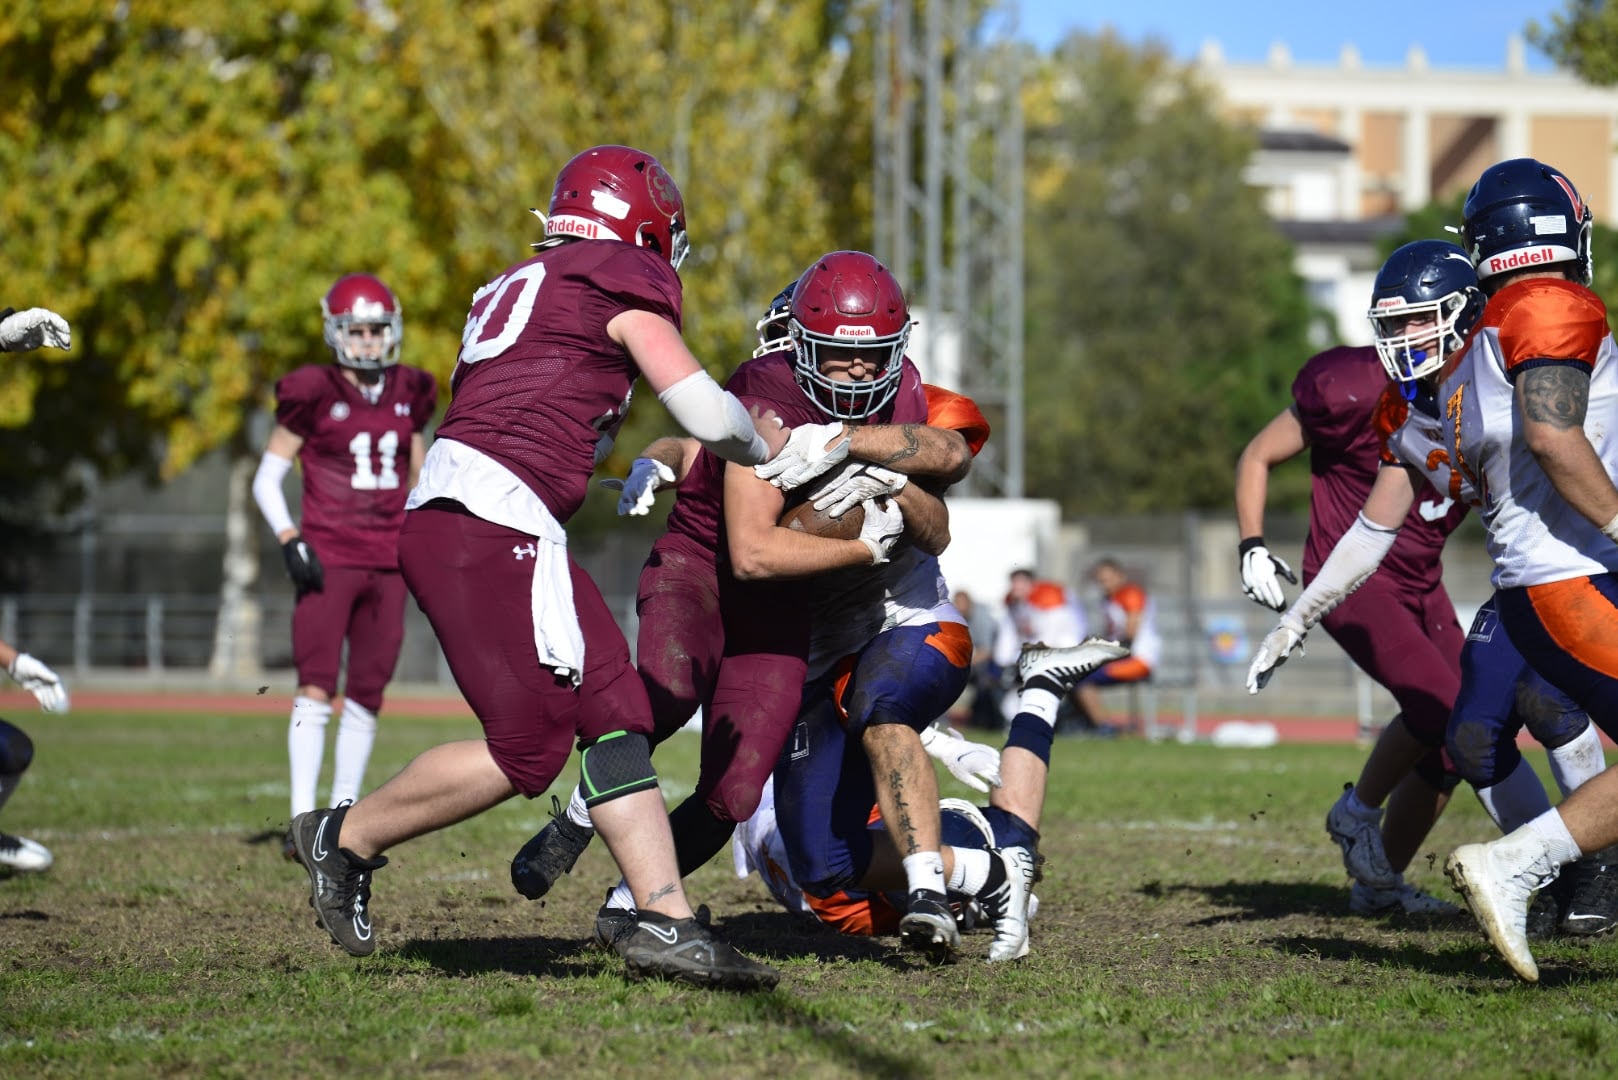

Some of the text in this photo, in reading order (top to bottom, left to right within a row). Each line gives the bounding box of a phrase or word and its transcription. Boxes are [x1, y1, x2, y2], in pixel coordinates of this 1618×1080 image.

[547, 218, 598, 239] Riddell
[1490, 248, 1553, 273] Riddell
[839, 328, 871, 337] Riddell
[349, 430, 399, 490] 11
